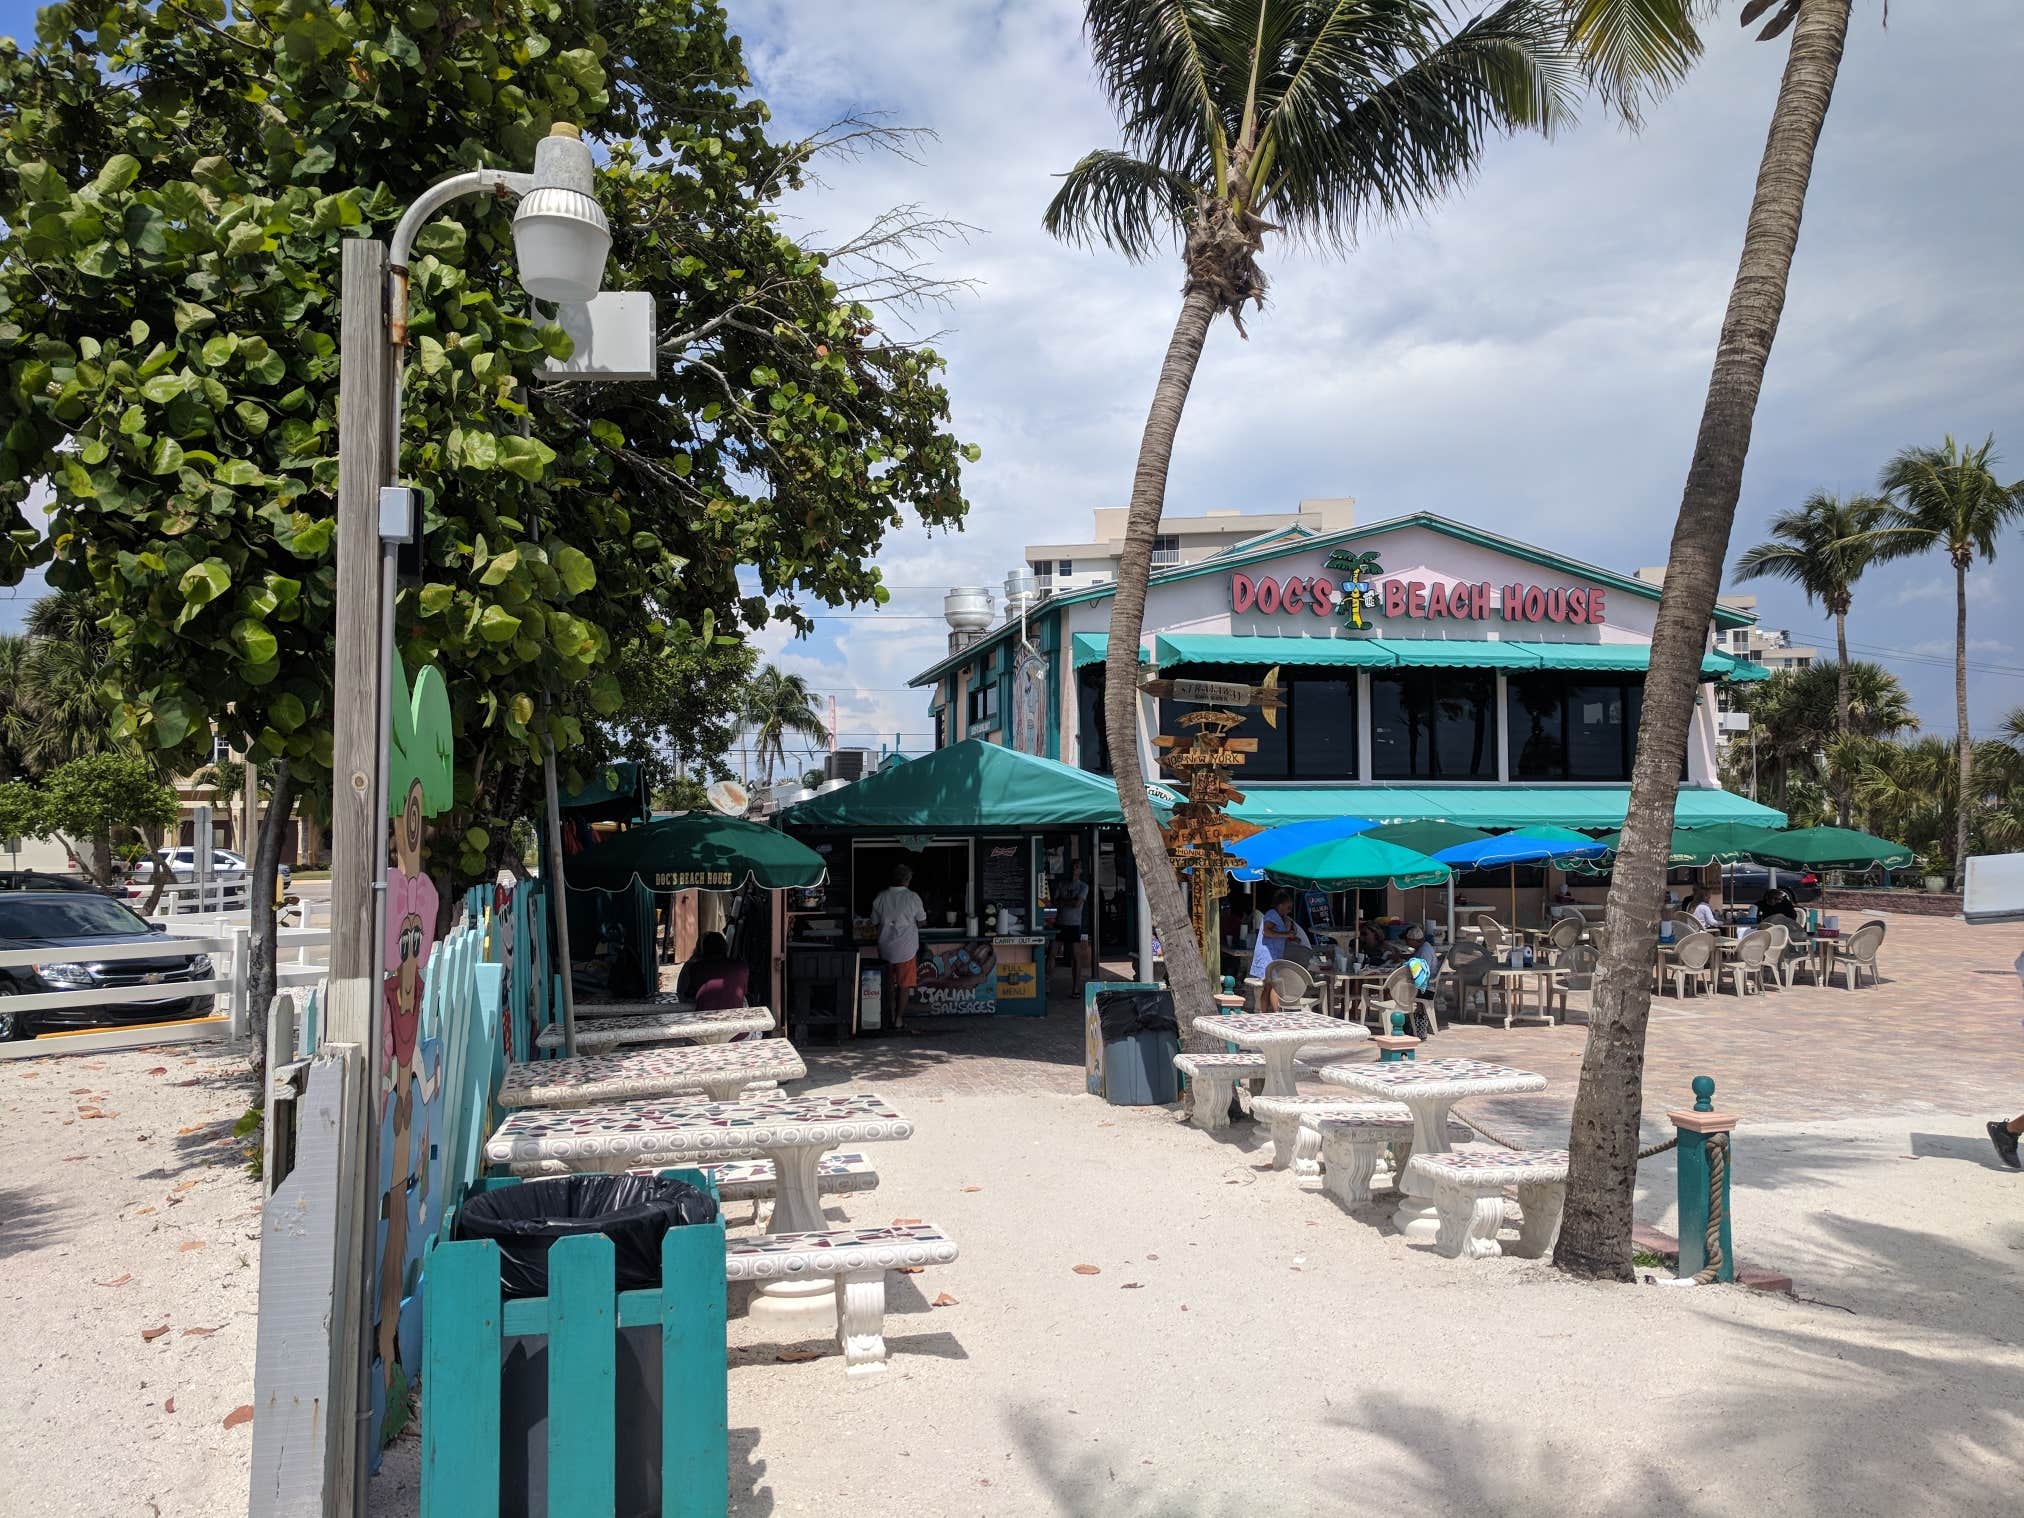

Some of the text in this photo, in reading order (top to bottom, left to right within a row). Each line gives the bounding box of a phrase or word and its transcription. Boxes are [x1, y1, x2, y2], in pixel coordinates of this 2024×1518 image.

[1230, 572, 1606, 624] DOC'S BEACH HOUSE
[1210, 752, 1240, 764] YORK
[1168, 828, 1221, 843] MEXICO
[655, 872, 733, 886] DOC'S BEACH HOUSE
[1003, 964, 1024, 973] FULL
[917, 986, 976, 1003] ITALIAN
[1002, 987, 1026, 996] MENU
[931, 1000, 996, 1015] SAUSAGES
